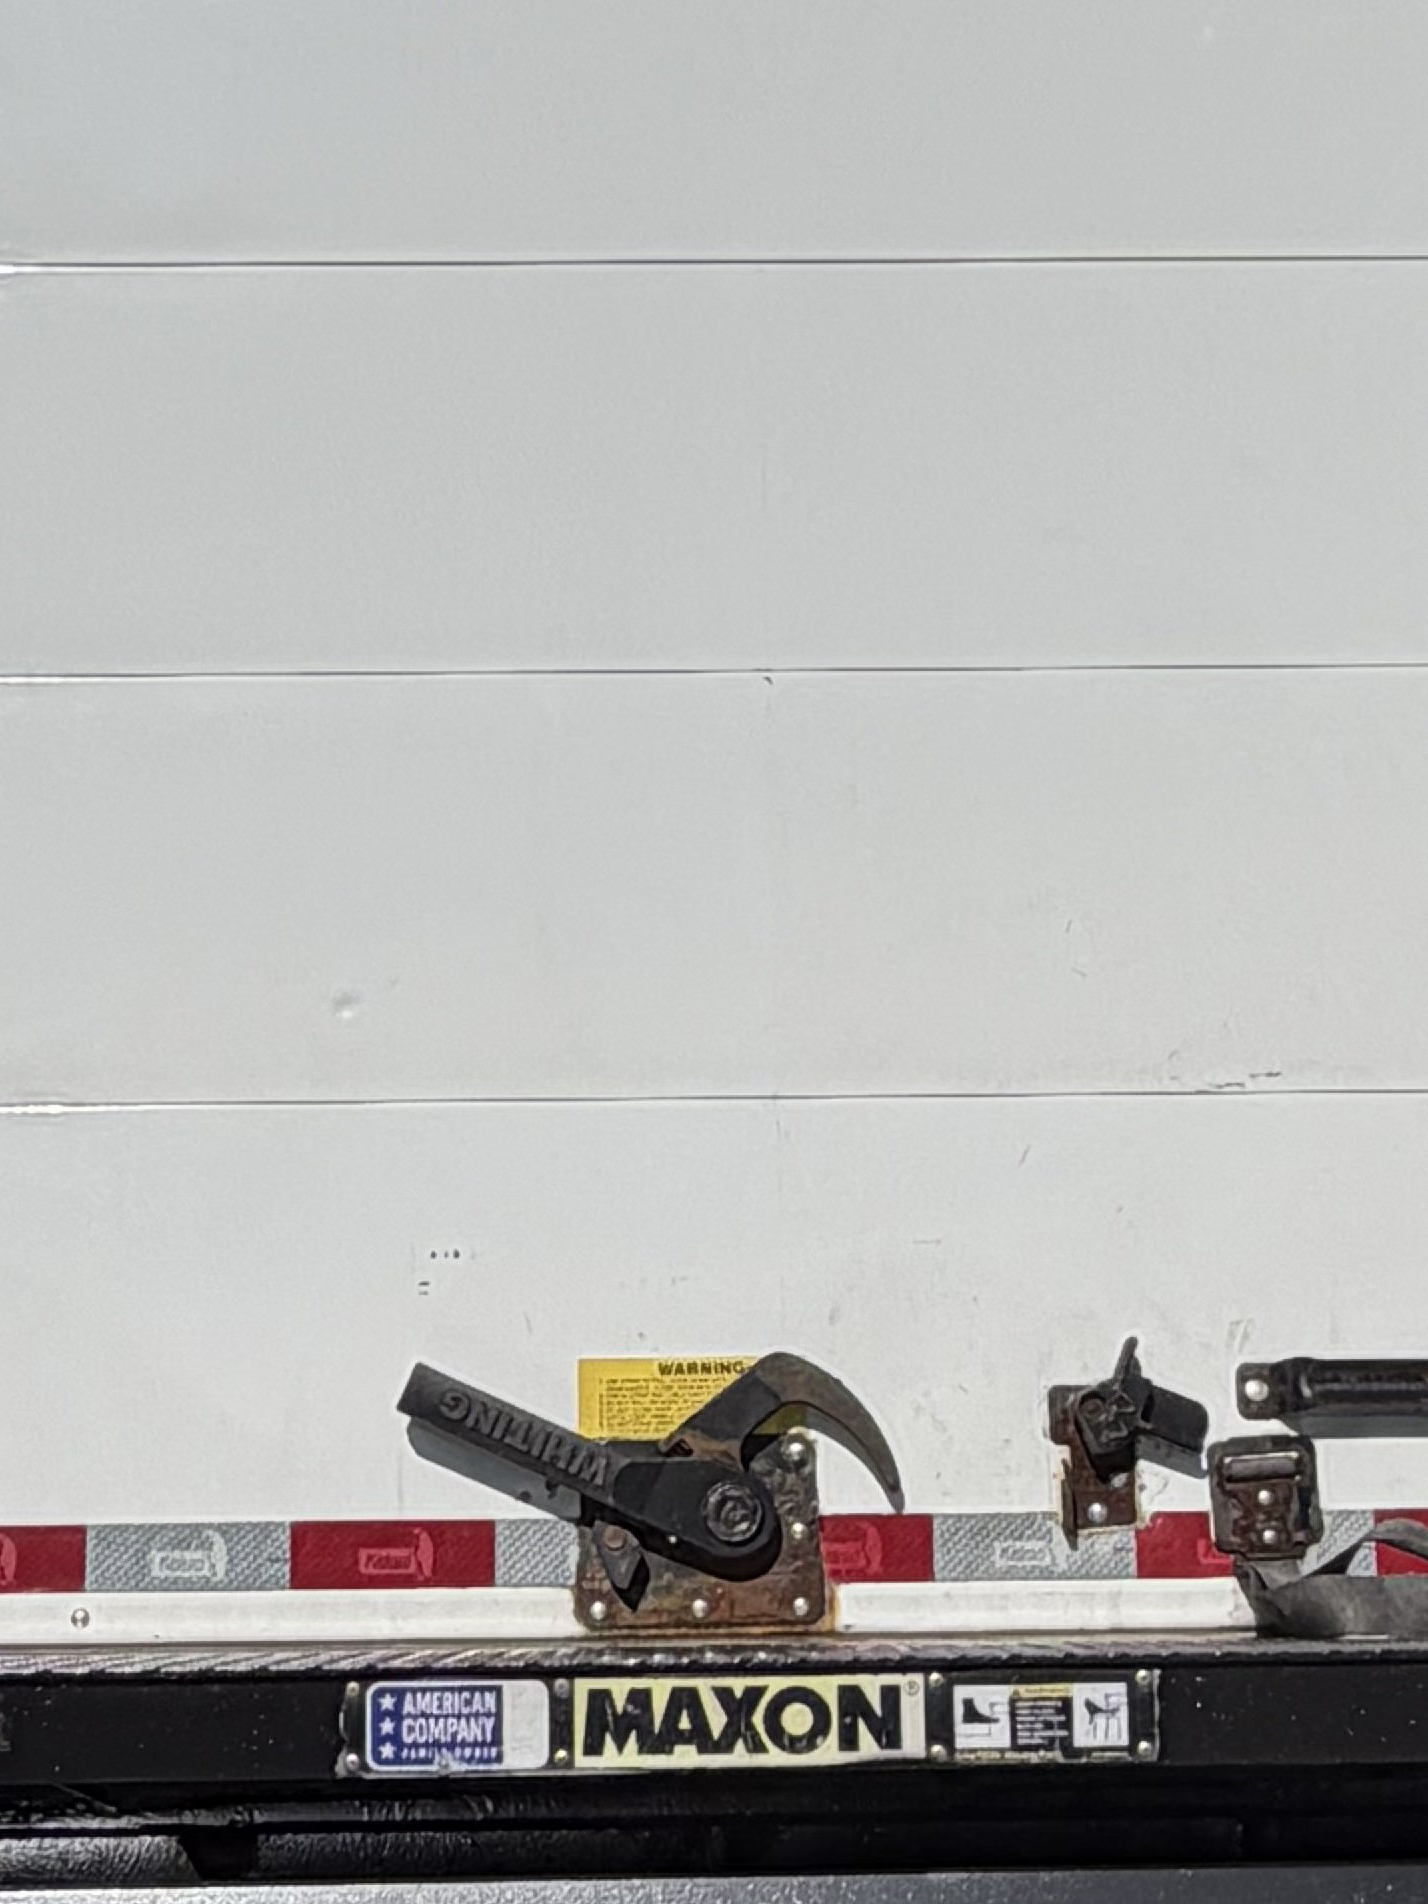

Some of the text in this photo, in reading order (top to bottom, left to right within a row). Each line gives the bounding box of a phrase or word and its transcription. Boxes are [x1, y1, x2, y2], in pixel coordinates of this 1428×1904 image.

[658, 1360, 744, 1376] WARNING
[438, 1389, 610, 1486] WHITING
[402, 1690, 497, 1715] AMERICAN
[401, 1716, 496, 1744] COMPANY
[583, 1684, 903, 1757] MAXON
